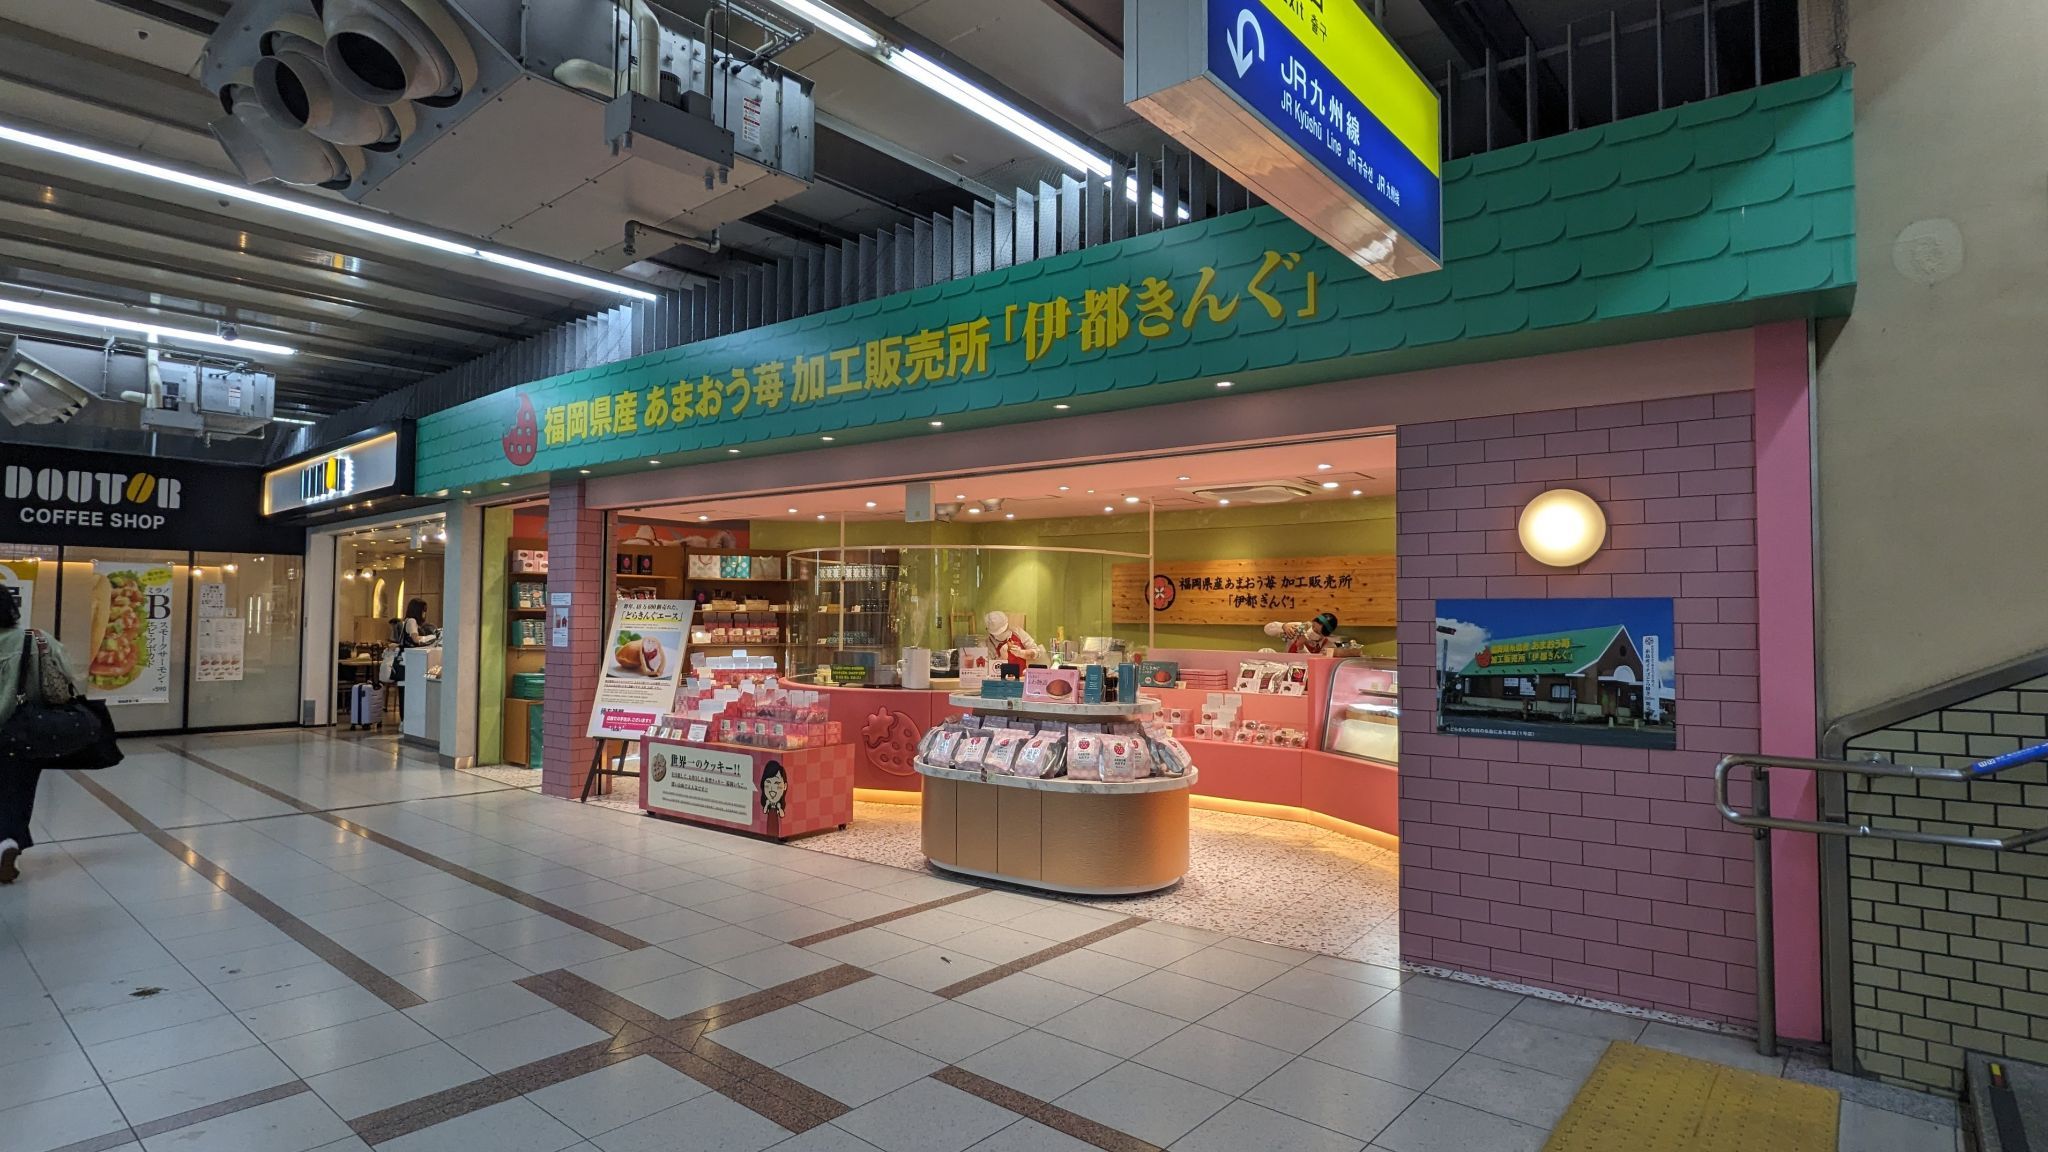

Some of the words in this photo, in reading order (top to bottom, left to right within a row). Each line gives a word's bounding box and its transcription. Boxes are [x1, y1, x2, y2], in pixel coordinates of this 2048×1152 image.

[1311, 14, 1328, 42] 출구
[1281, 90, 1293, 116] JR
[1295, 100, 1322, 140] Kyūshū
[1326, 128, 1342, 157] Line
[544, 391, 638, 445] 福岡県産
[643, 361, 785, 427] あまおう苺
[5, 465, 182, 509] DOUTOR
[20, 507, 103, 527] COFFEE
[110, 513, 165, 530] SHOP
[146, 594, 171, 620] B
